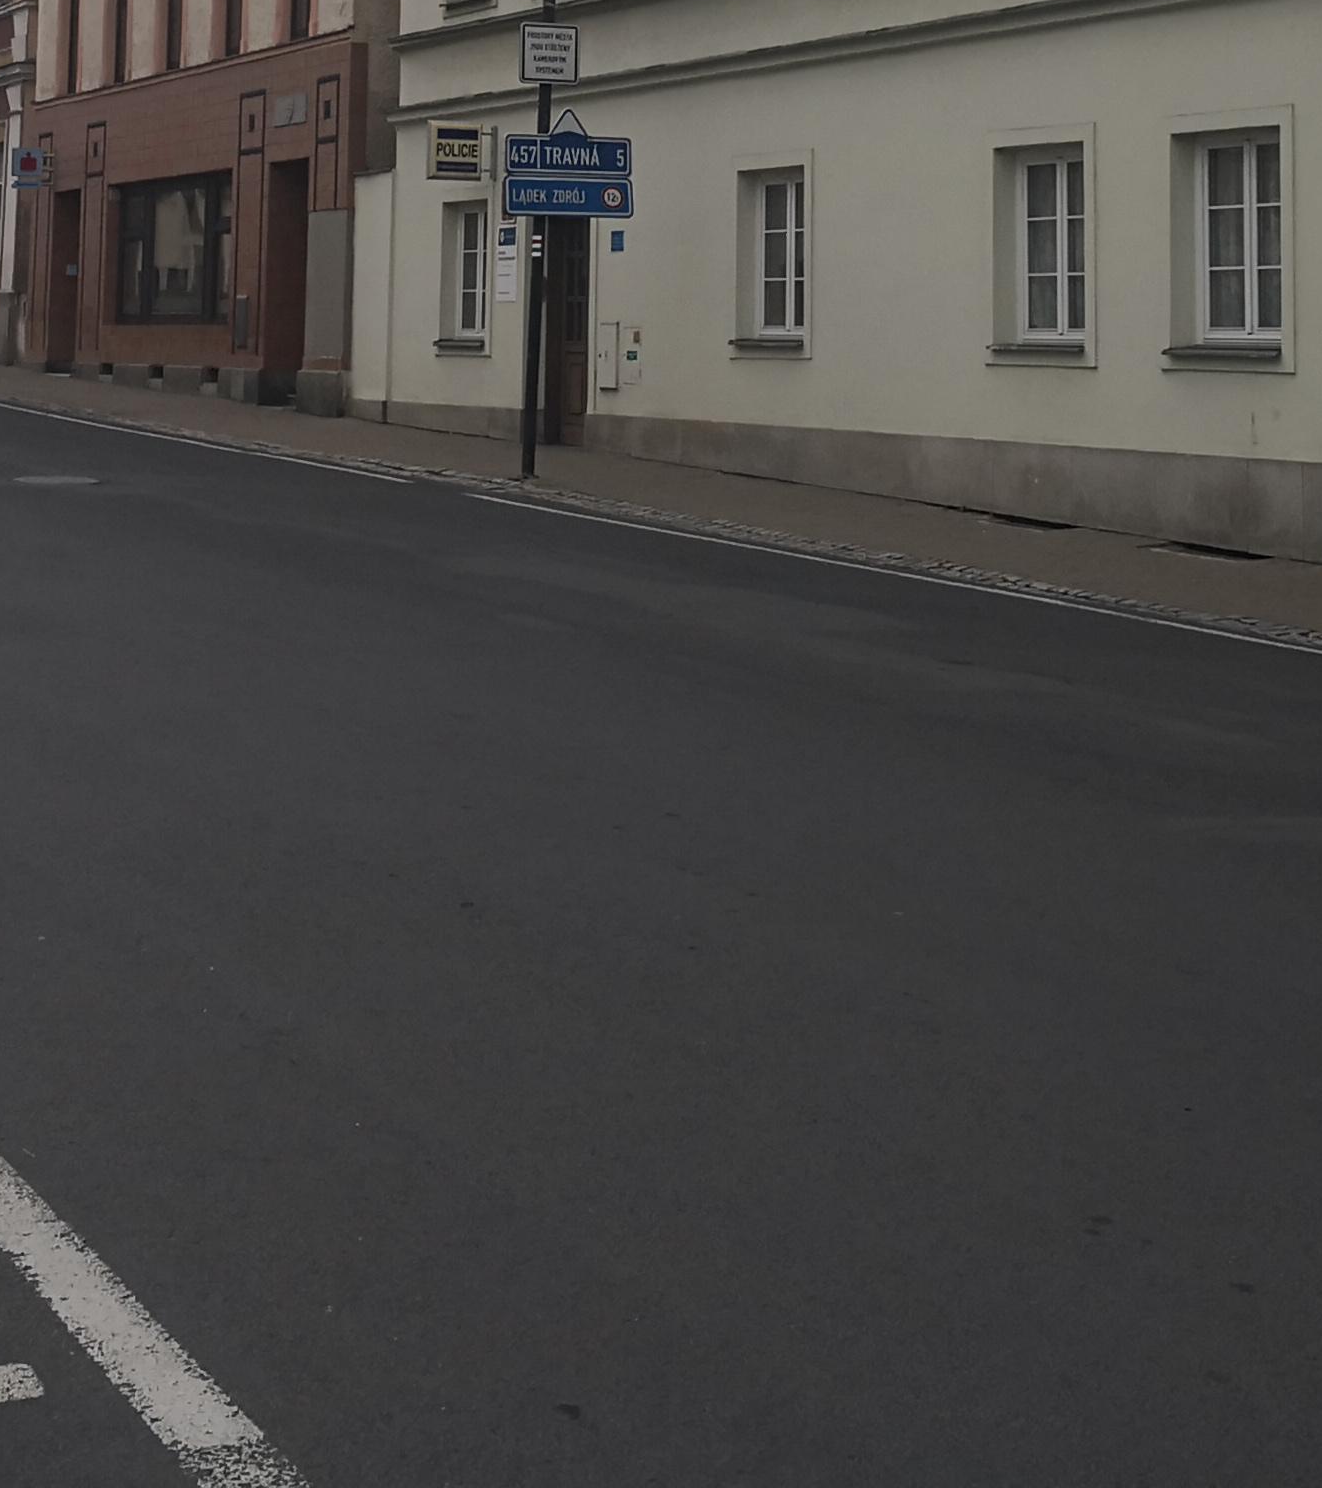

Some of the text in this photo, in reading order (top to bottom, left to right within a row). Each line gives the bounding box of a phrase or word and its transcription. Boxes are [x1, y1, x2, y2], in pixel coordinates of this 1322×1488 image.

[436, 142, 479, 158] POLICIE
[510, 144, 625, 167] 457 TRAVNÁ 5
[512, 187, 547, 205] LĄDEK
[552, 188, 586, 204] ZDRÓJ
